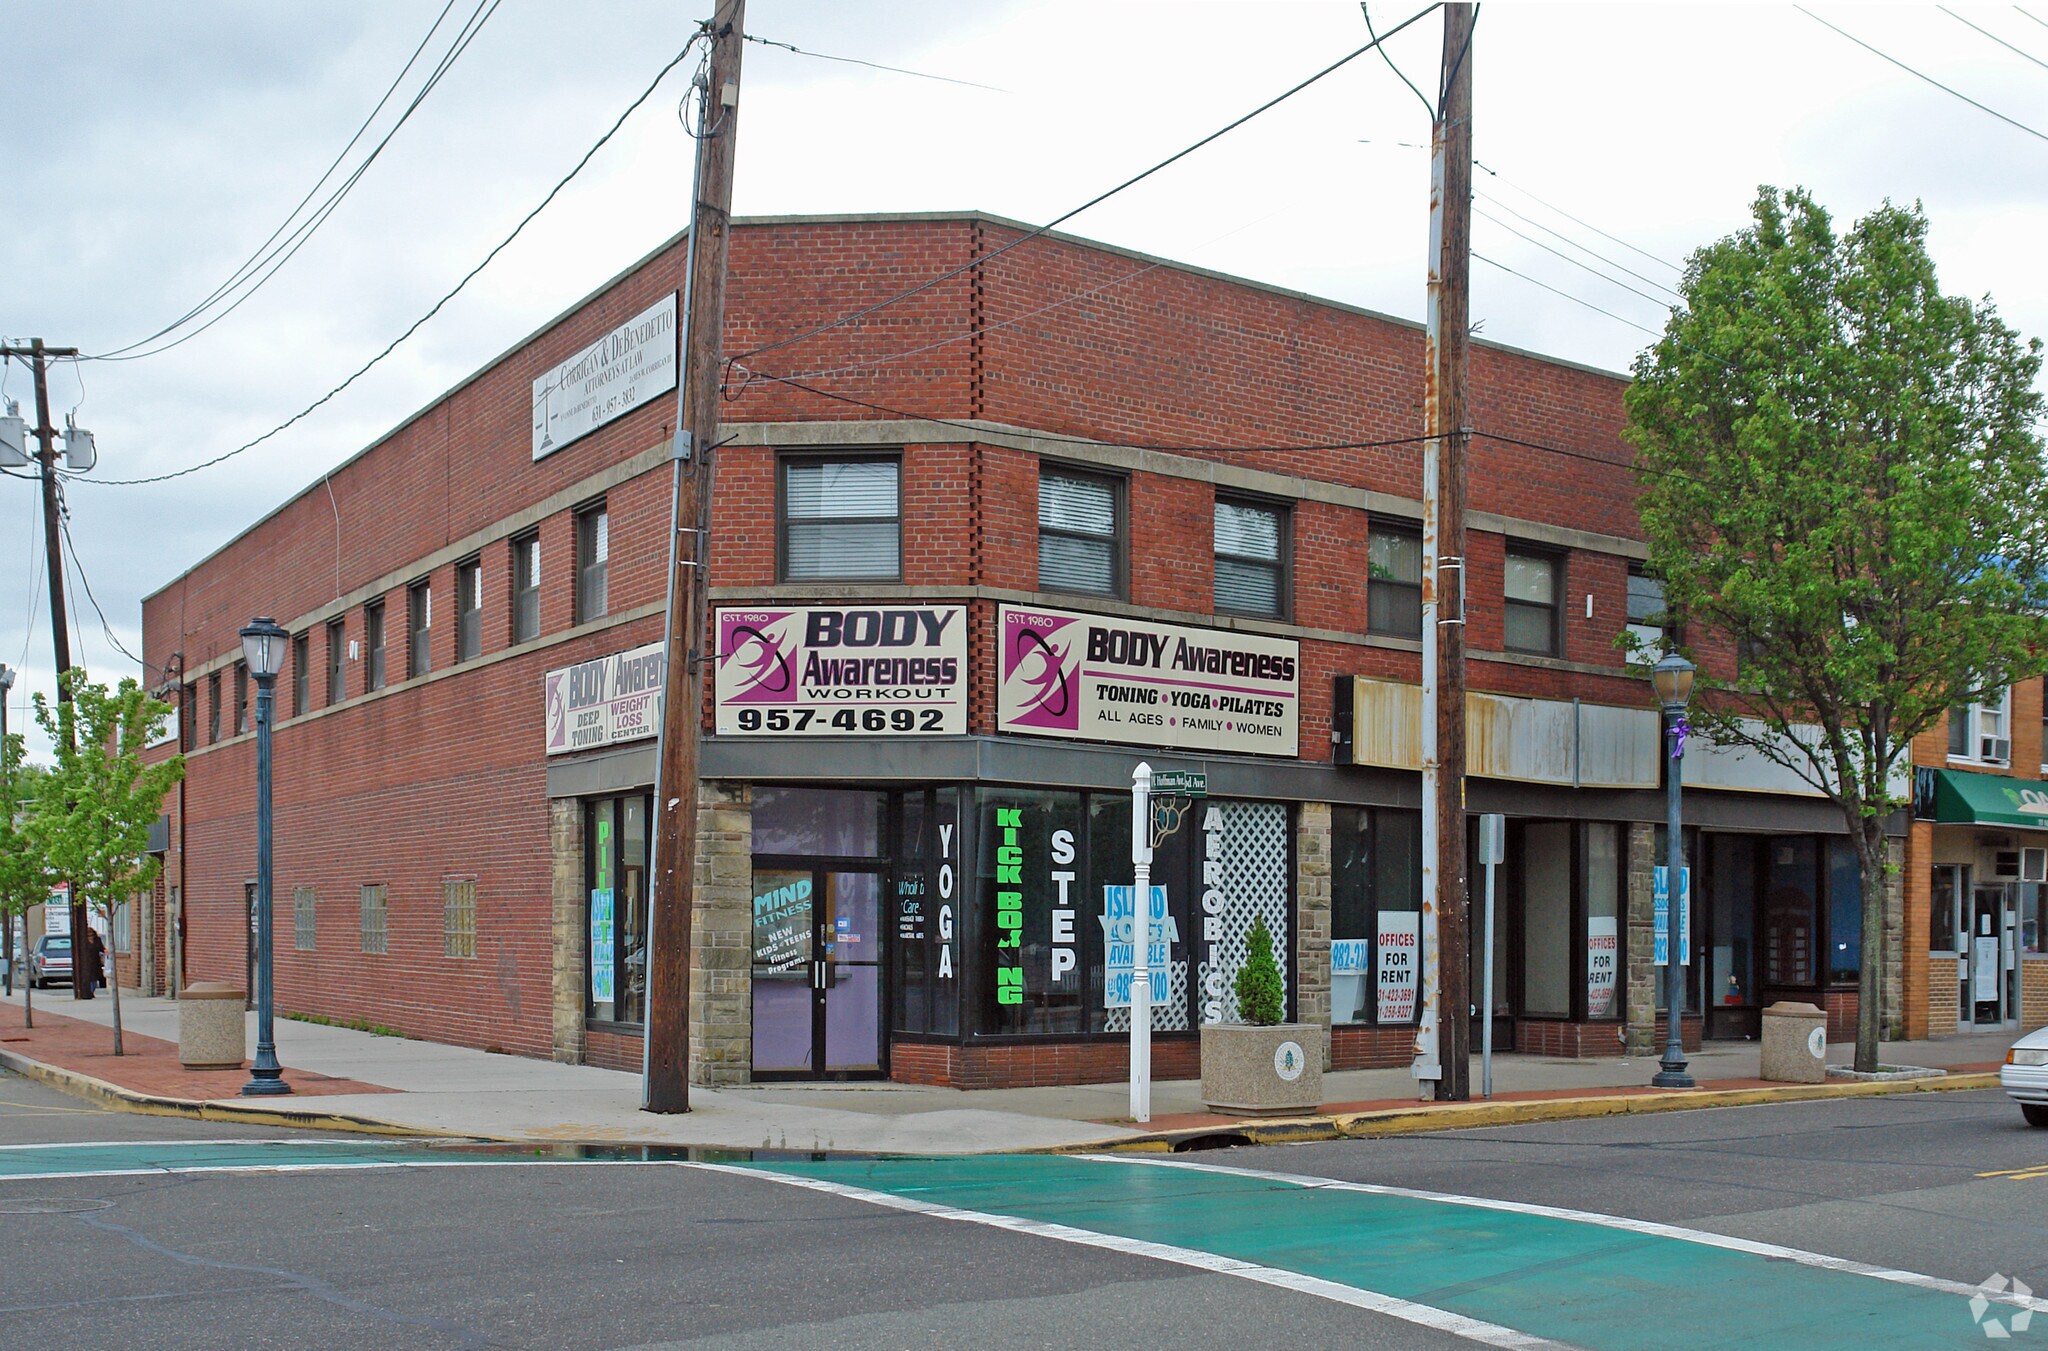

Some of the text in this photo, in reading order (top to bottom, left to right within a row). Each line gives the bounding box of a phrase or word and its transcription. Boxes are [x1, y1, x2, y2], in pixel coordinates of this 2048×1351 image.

[560, 351, 599, 391] CORRIGAN
[601, 339, 609, 367] &
[583, 348, 644, 397] ATTORNEYS AT LAW
[743, 613, 769, 623] 1980
[803, 609, 960, 648] BODY
[1027, 616, 1054, 628] 1980
[1086, 626, 1296, 682] BODY Awareness
[800, 650, 958, 687] Awareness
[569, 658, 610, 709] BODY
[807, 688, 951, 699] WORKOUT
[611, 695, 651, 716] WEIGHT
[1096, 684, 1284, 718] TONING YOGA PILATES
[577, 710, 600, 728] DEEP
[617, 712, 643, 730] LOSS
[738, 708, 944, 732] 957-4692
[1098, 709, 1283, 737] ALL AGES FAMILY WOMEN
[572, 725, 604, 747] TONING
[611, 725, 650, 740] CENTER
[753, 879, 813, 916] MIND
[903, 899, 920, 914] Care
[938, 822, 953, 980] YOGA
[1050, 829, 1077, 981] STEP
[1107, 886, 1165, 920] ISLD
[754, 900, 813, 928] FITNESS
[1202, 807, 1225, 1025] AEROBICS
[756, 943, 779, 958] KIDS
[784, 929, 812, 947] TEENS
[768, 926, 793, 943] NEW
[1379, 933, 1415, 946] OFFICES
[1588, 937, 1616, 950] OFFICES
[767, 956, 806, 975] Programs
[770, 948, 798, 964] Fitness
[1385, 952, 1408, 966] FOR
[1593, 955, 1610, 968] FOR
[1381, 970, 1411, 983] RENT
[1588, 971, 1612, 984] RENT
[1378, 988, 1415, 1002] 31-423-3691
